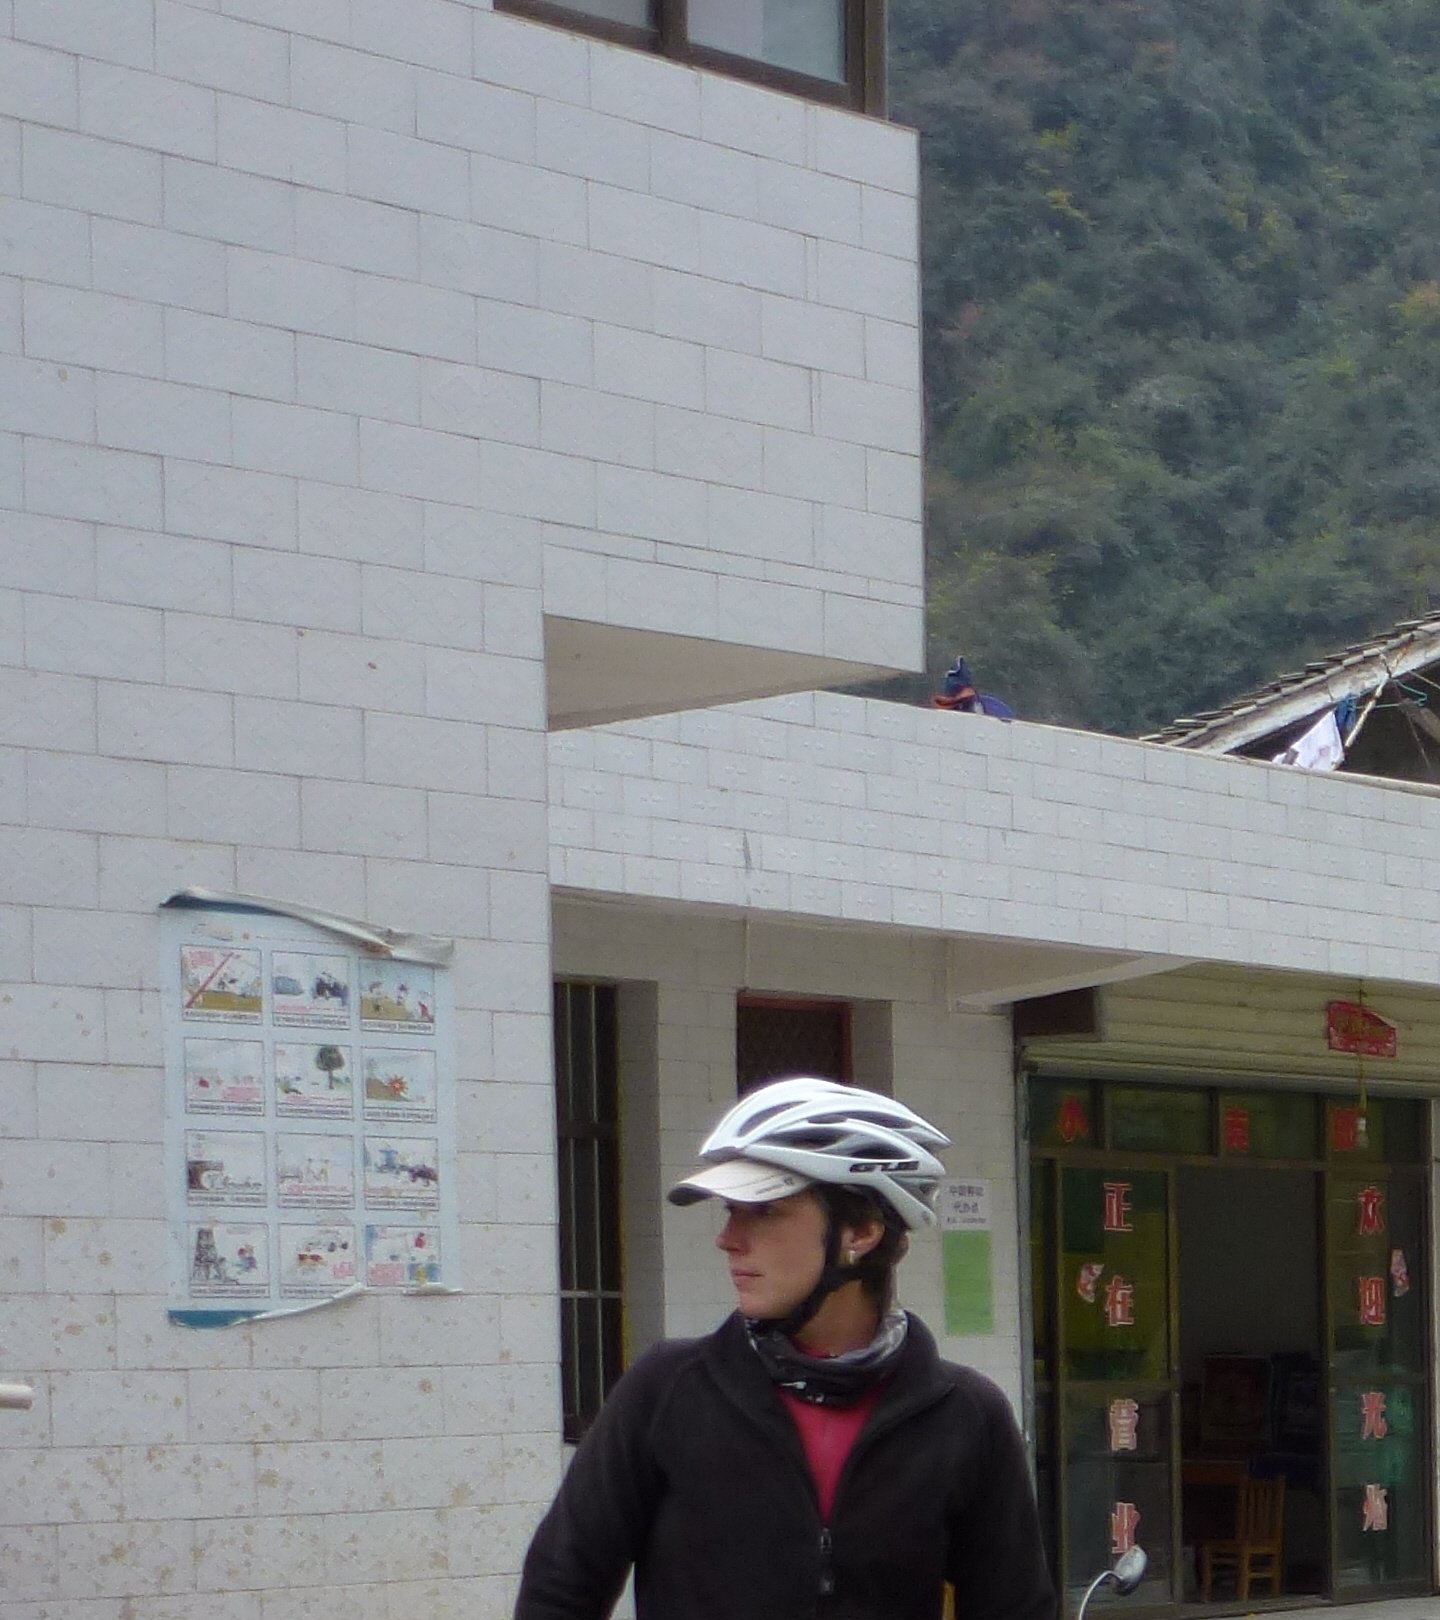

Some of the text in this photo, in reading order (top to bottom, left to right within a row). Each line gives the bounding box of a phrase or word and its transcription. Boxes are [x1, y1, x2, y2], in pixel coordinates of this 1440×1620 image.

[1102, 1182, 1141, 1554] 正在营业
[1357, 1184, 1389, 1532] 欢迎光临
